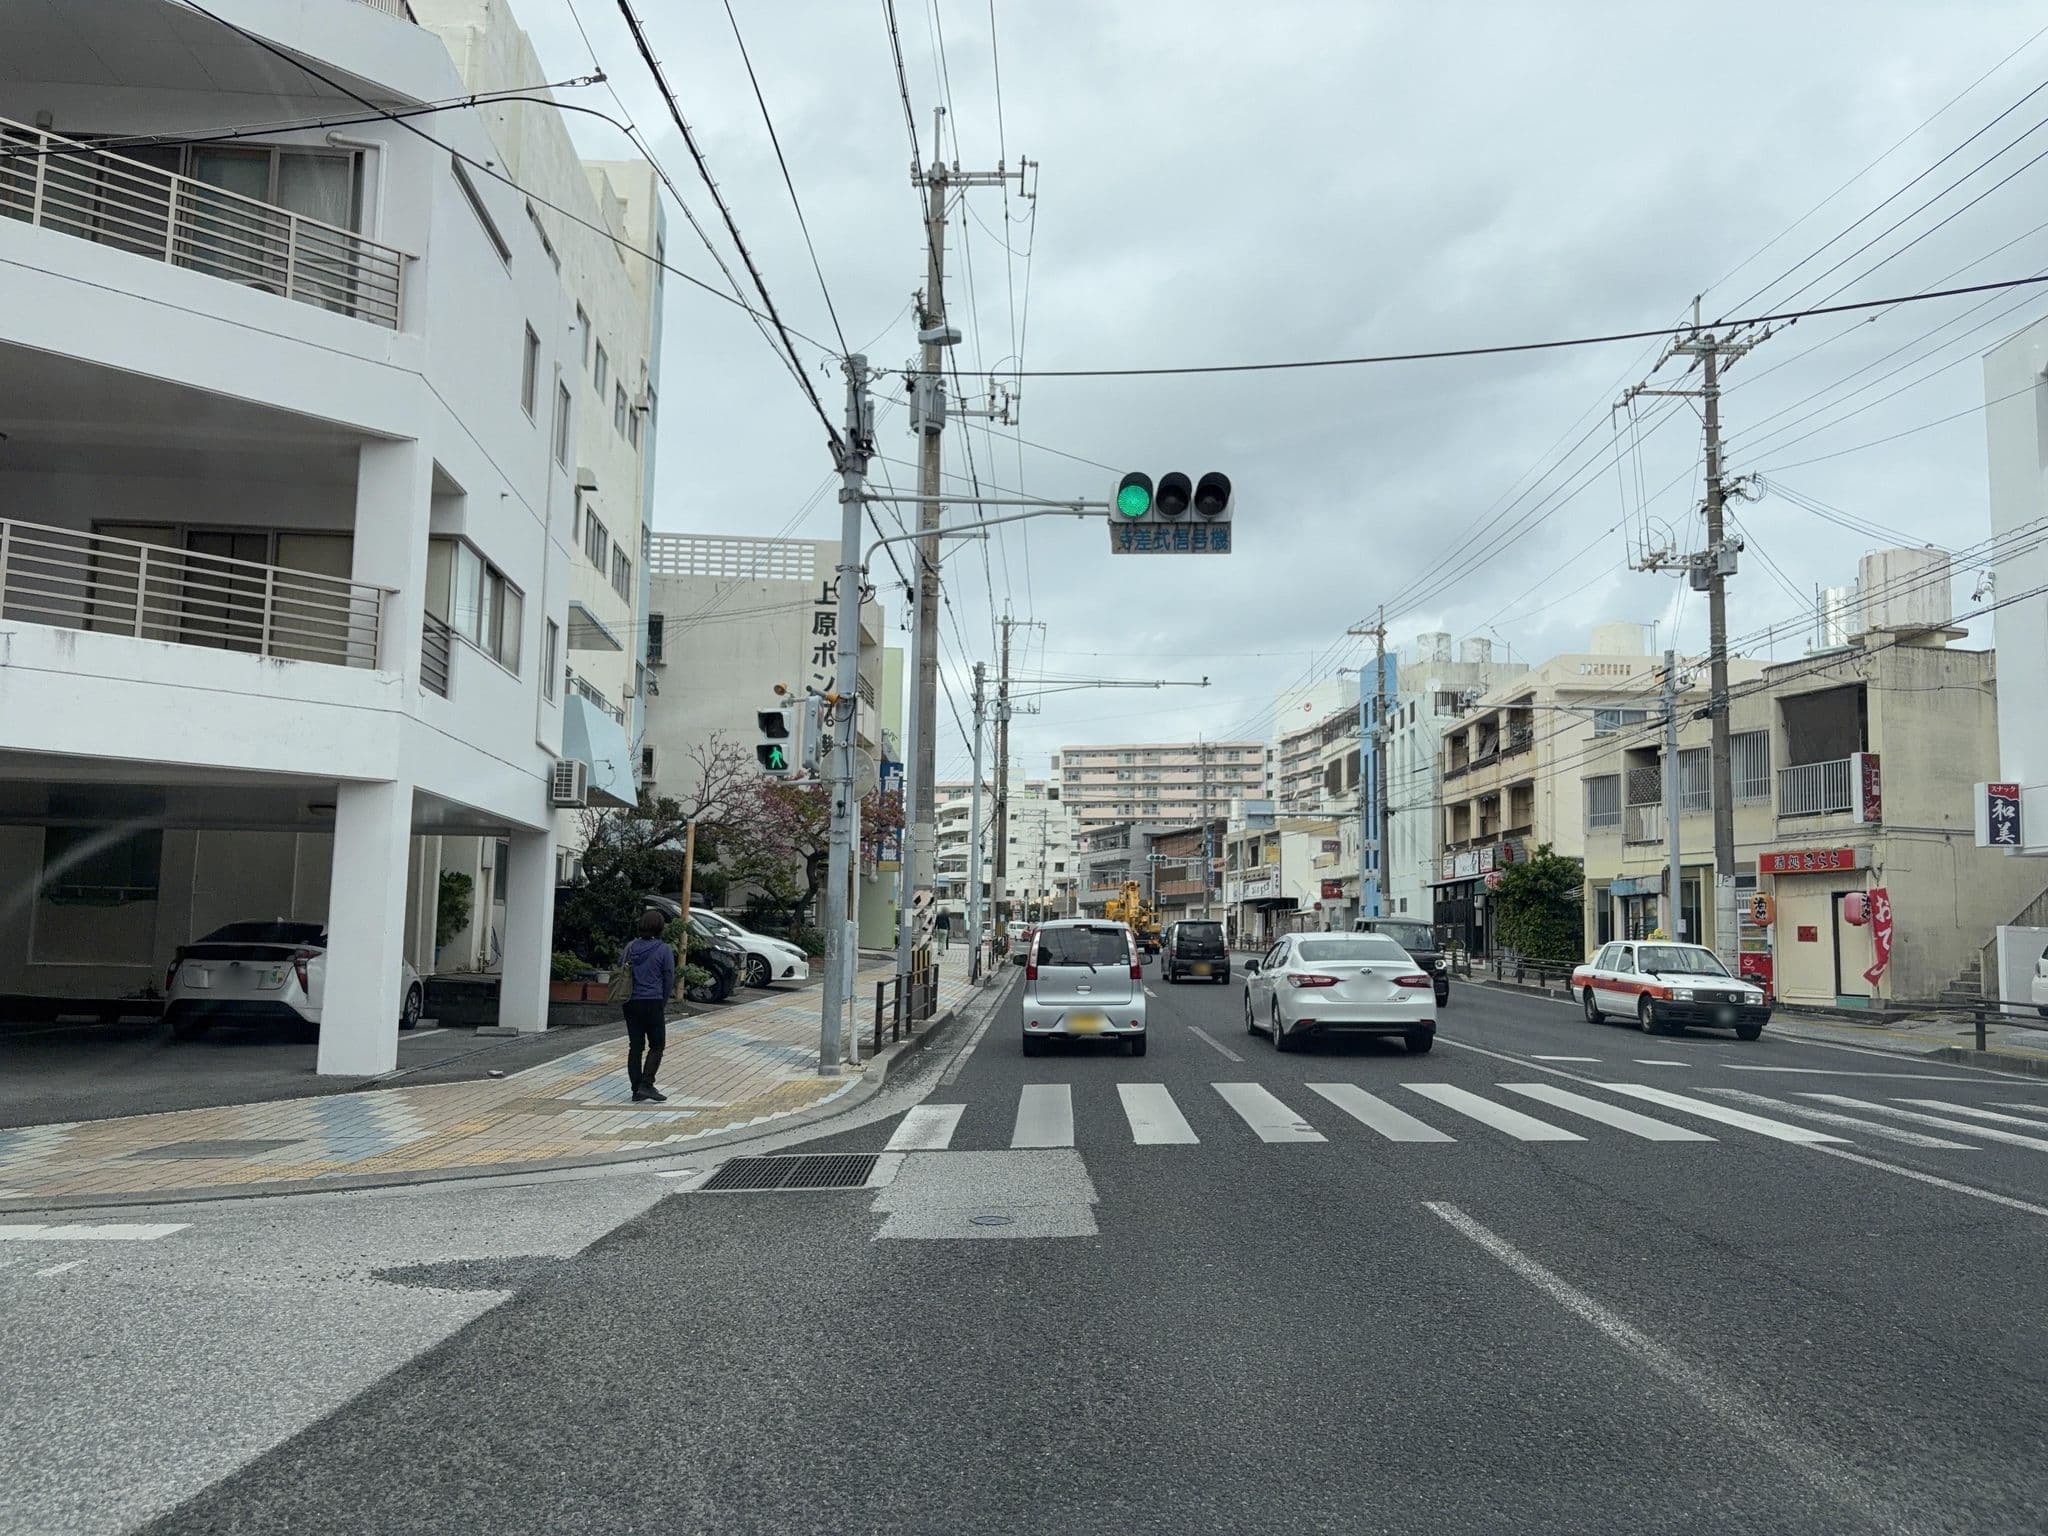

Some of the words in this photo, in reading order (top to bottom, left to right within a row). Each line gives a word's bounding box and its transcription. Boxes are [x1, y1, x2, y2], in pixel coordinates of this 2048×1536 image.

[1991, 785, 2016, 793] スナック
[1991, 798, 2016, 844] 和美
